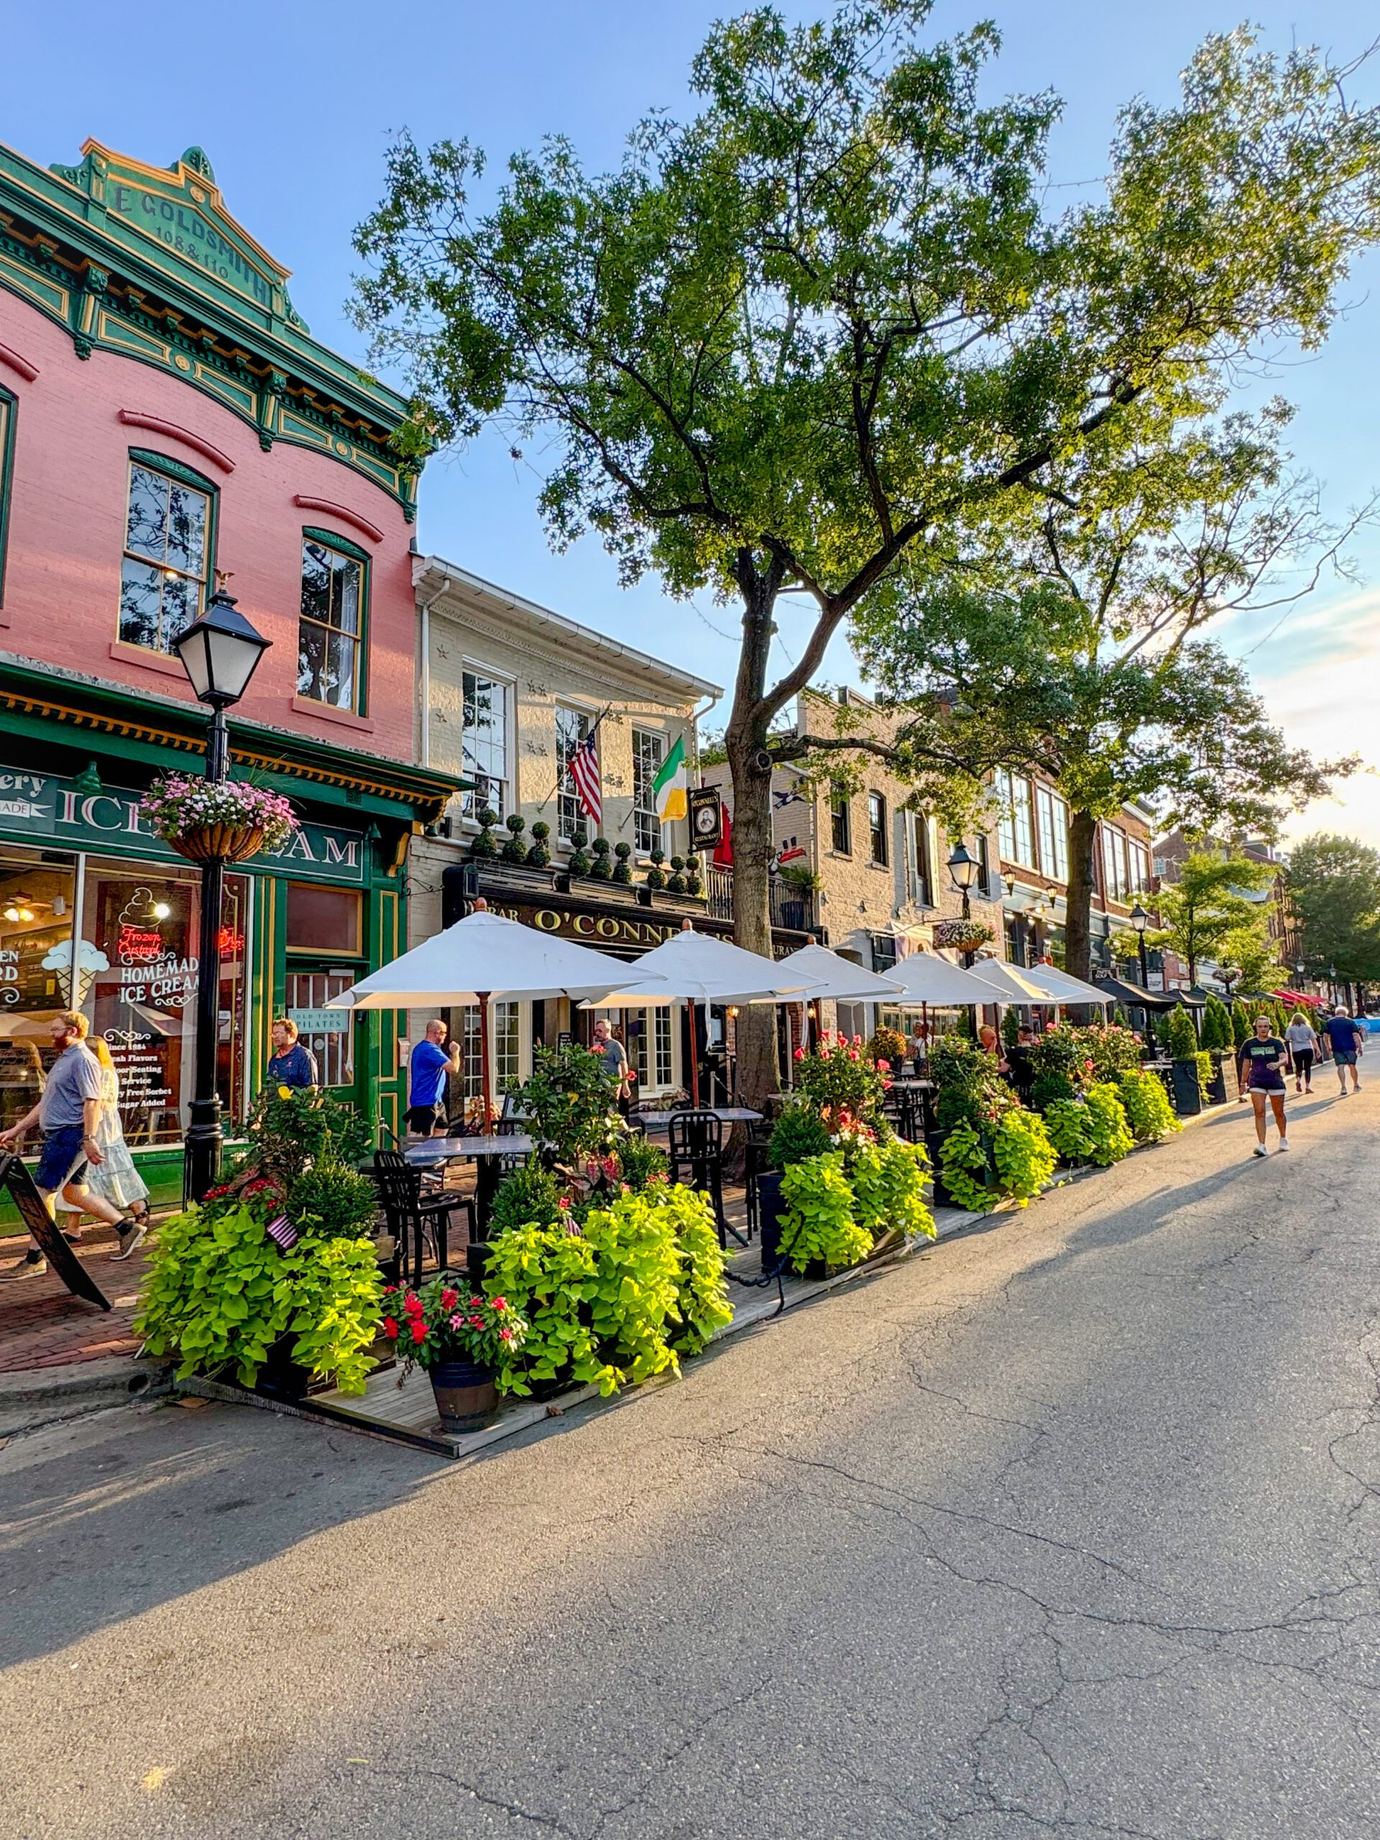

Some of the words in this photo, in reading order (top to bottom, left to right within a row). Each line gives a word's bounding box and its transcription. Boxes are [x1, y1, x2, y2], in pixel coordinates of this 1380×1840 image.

[115, 187, 132, 213] E
[141, 195, 267, 305] GOLDSMITH
[55, 789, 157, 840] ICE
[121, 957, 199, 984] HOMEMAD
[119, 985, 147, 1003] ICE
[127, 1054, 158, 1062] Flavors
[129, 1065, 162, 1074] Seating
[121, 1077, 152, 1085] Service
[126, 1089, 145, 1097] Free
[140, 1099, 166, 1107] Added
